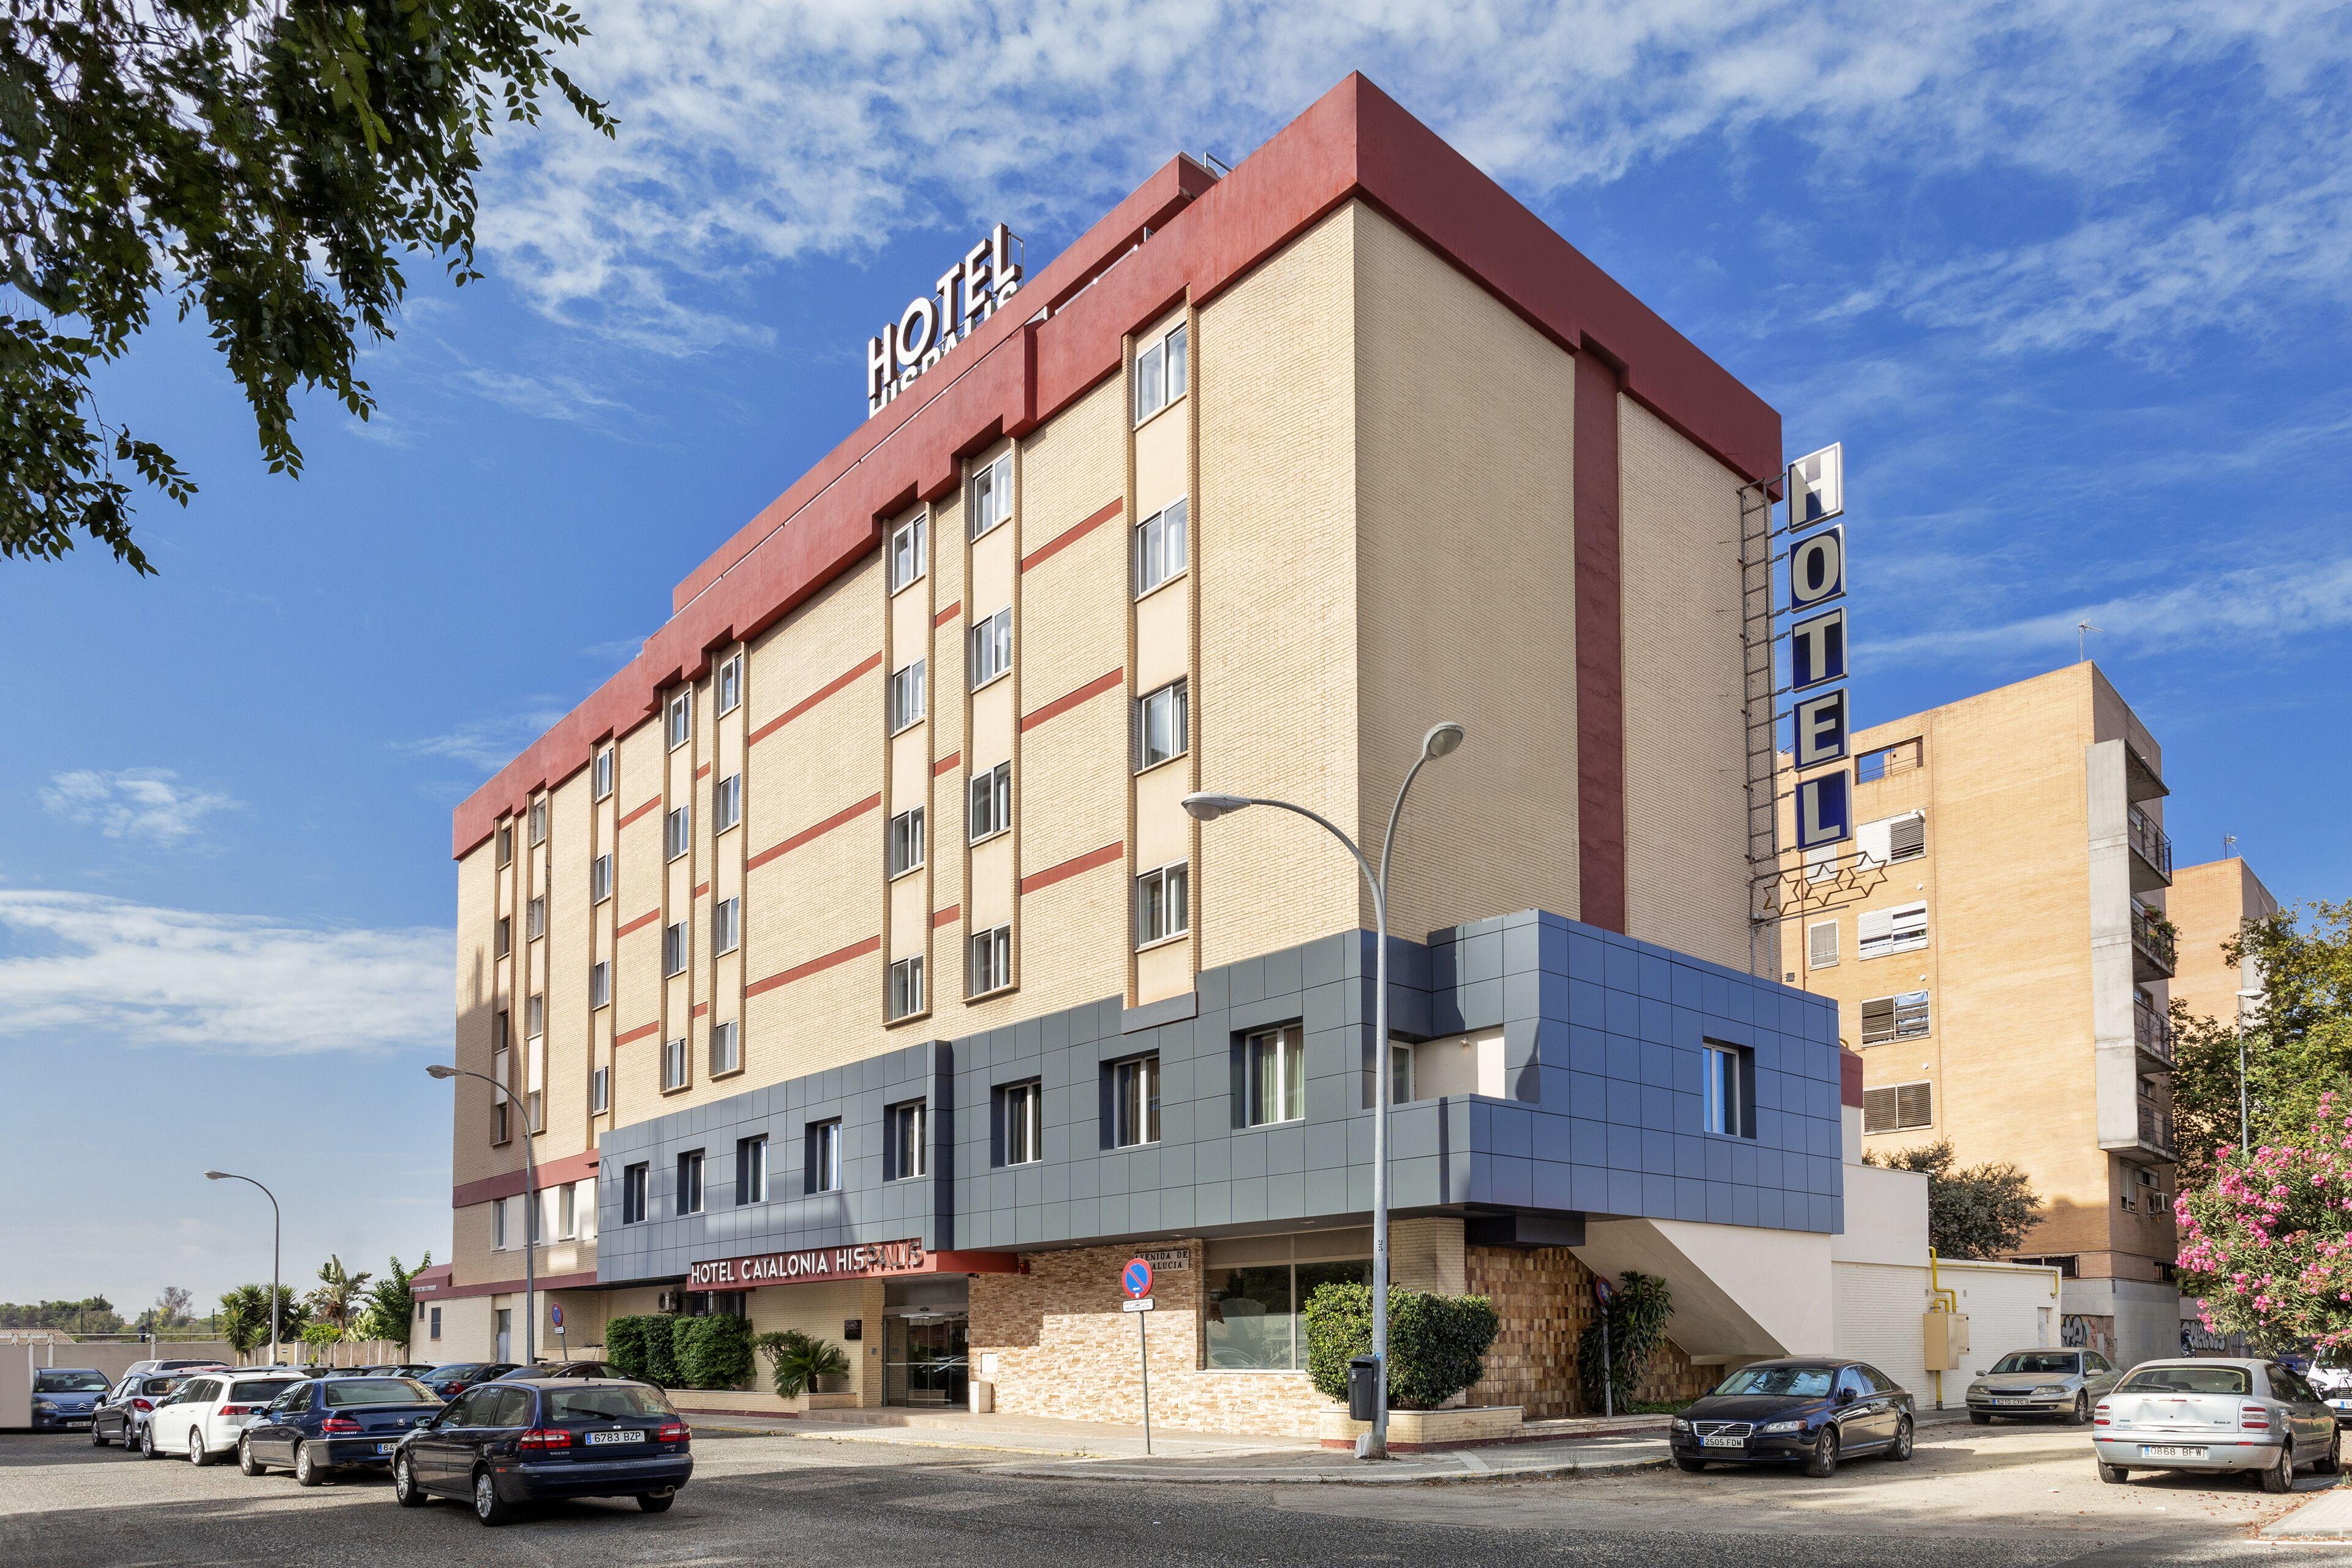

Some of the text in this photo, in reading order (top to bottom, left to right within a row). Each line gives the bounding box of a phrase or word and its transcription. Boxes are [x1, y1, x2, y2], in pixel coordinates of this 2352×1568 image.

[869, 222, 1020, 399] HOTEL
[1791, 449, 1841, 845] HOTEL
[691, 1242, 921, 1284] HOTEL CATALONIA HISPALIS
[594, 1432, 641, 1442] 6783 BZP
[2150, 1447, 2201, 1457] 0868 BFW
